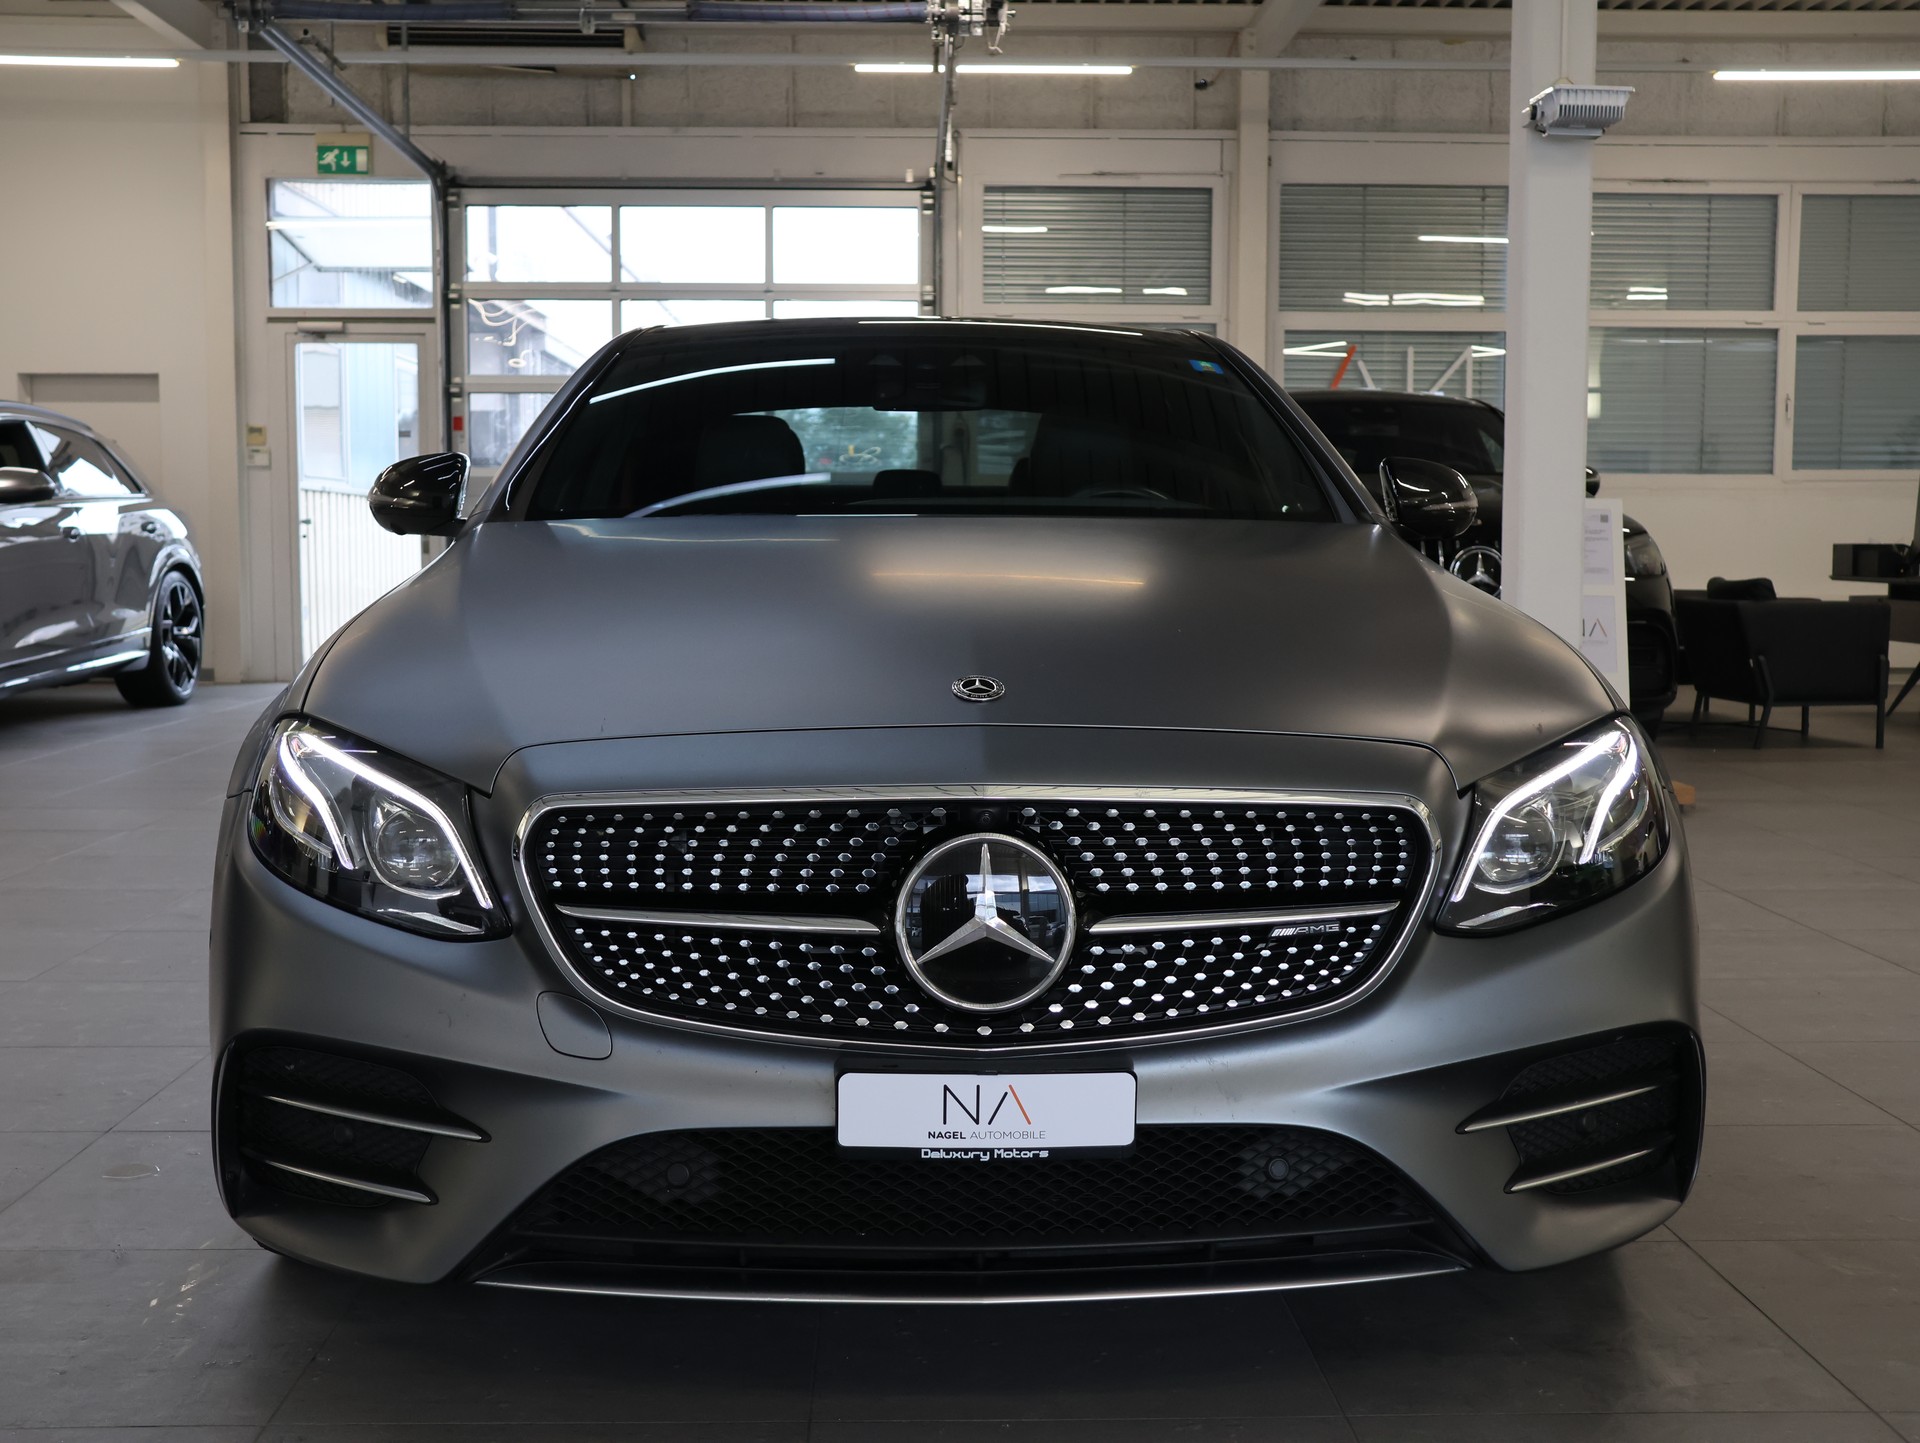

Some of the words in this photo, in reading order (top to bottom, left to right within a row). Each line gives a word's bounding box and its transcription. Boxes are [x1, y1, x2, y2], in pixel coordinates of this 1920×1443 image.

[1294, 923, 1340, 934] AMG
[928, 1131, 966, 1140] NAGEL
[969, 1130, 1046, 1140] AUTOMOBILE
[921, 1149, 990, 1161] Deluxury
[994, 1148, 1049, 1159] Motors
